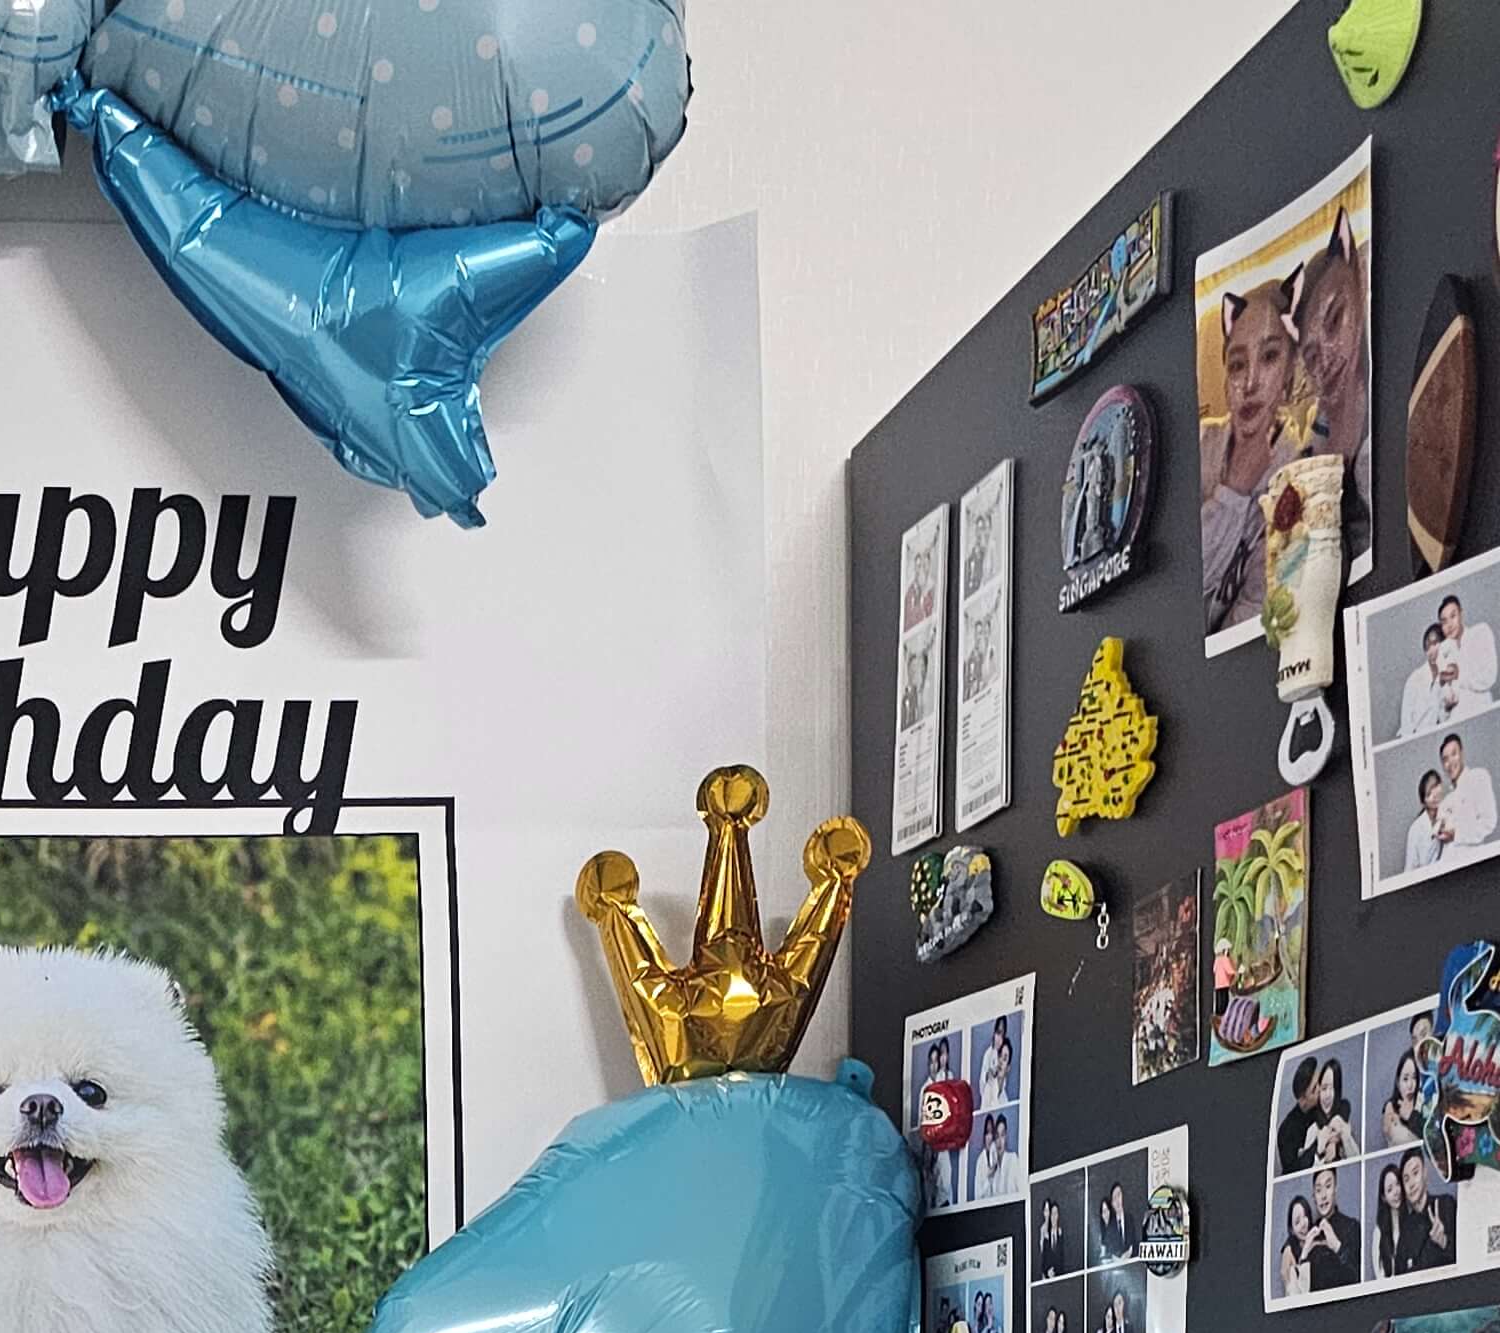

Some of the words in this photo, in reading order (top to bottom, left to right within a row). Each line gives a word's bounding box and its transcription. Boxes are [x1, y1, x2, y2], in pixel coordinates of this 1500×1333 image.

[1058, 545, 1132, 613] SINGAPORE
[911, 1019, 950, 1041] PHOTOGRAY
[1140, 1242, 1184, 1260] HAWAII
